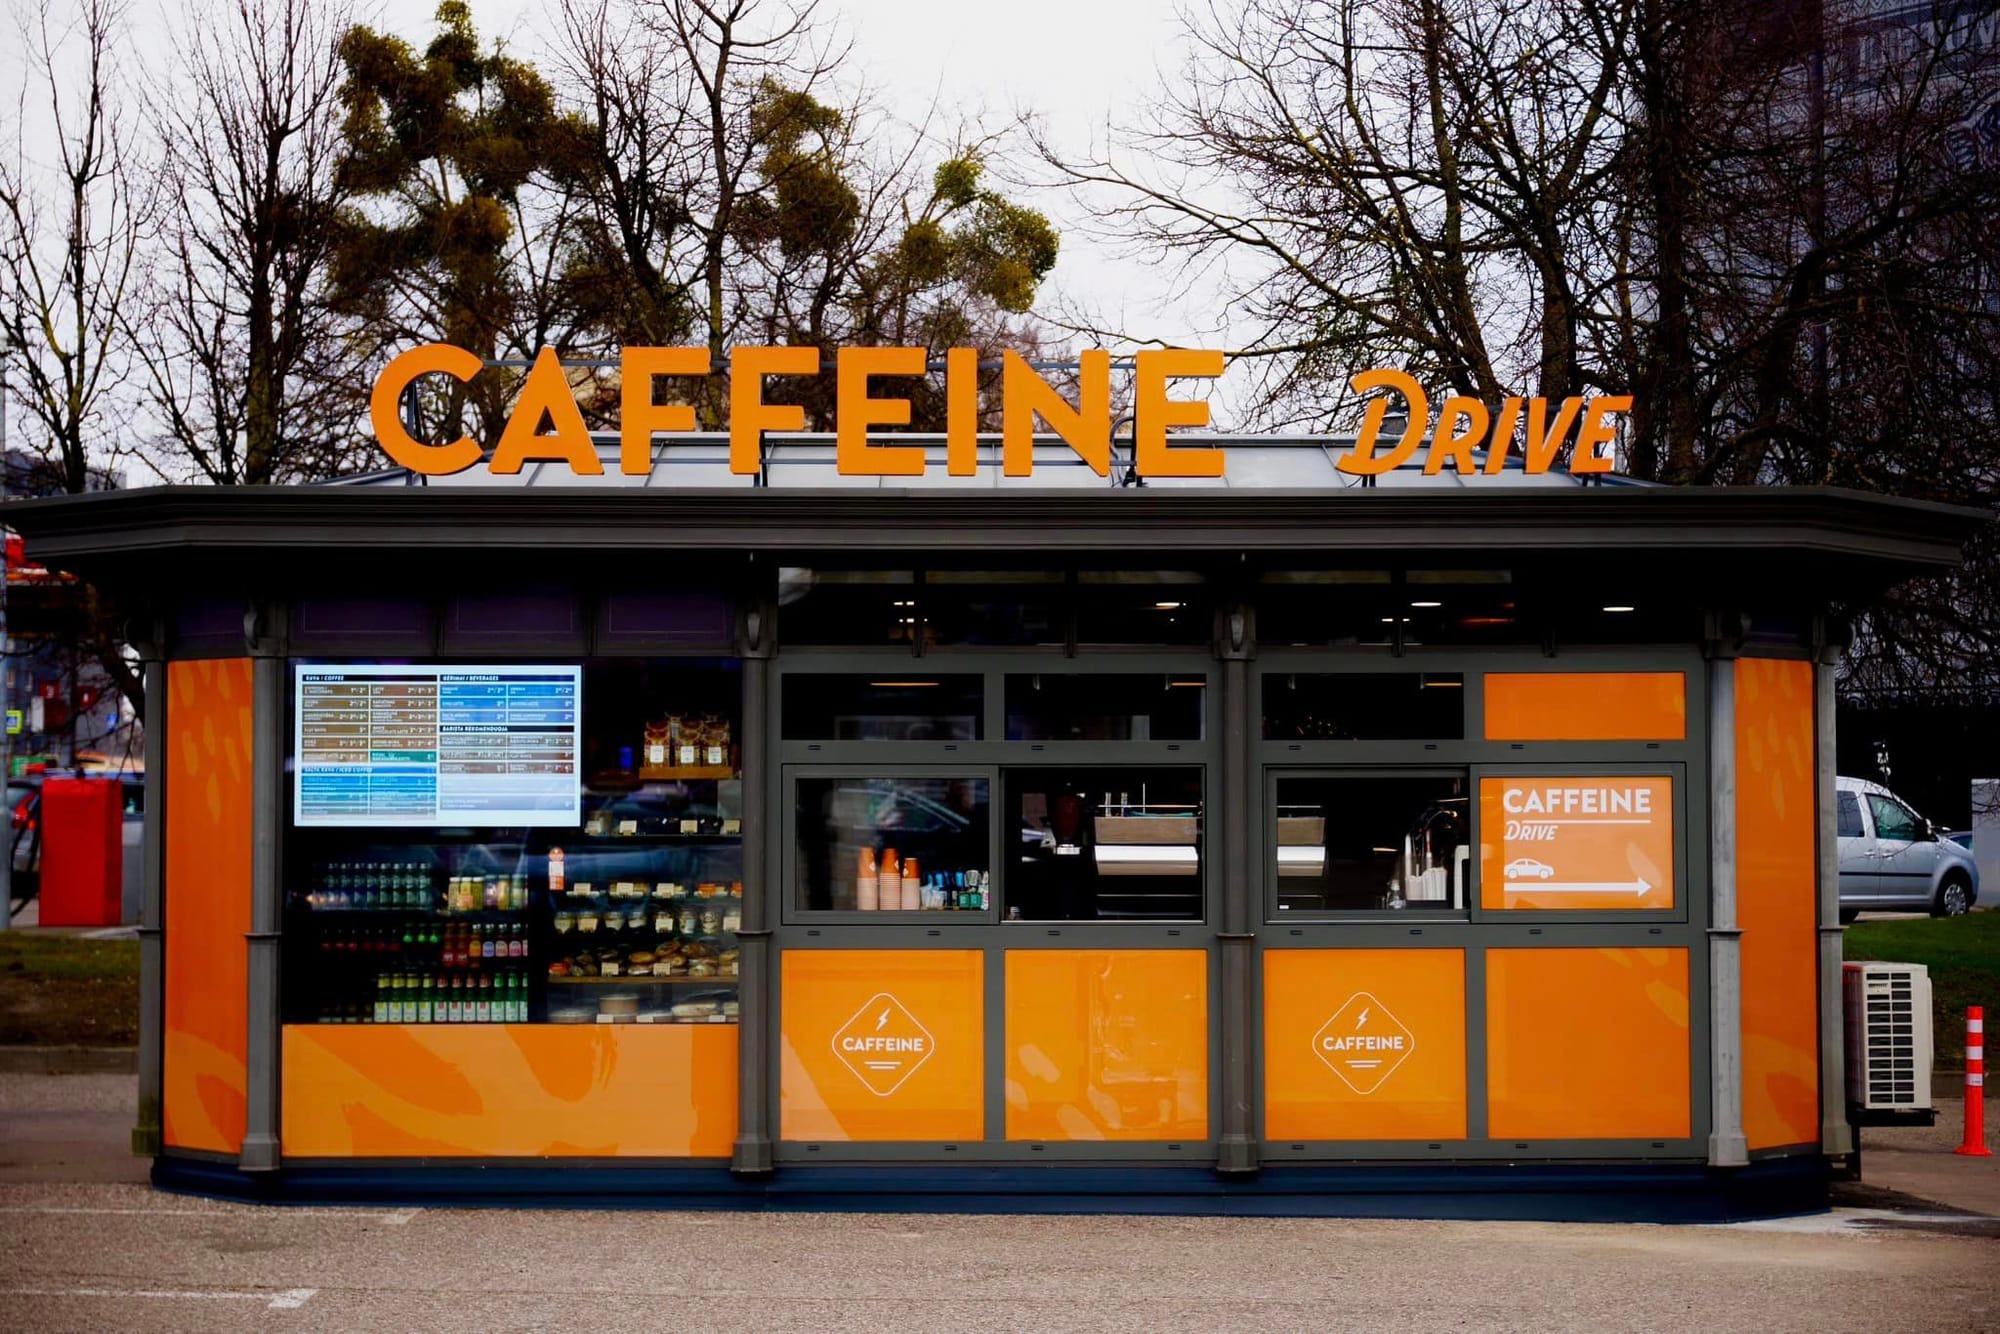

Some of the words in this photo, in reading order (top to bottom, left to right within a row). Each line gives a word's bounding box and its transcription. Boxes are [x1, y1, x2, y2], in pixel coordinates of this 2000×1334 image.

[369, 344, 1225, 477] CAFFEINE
[1335, 368, 1634, 476] DRIVE
[1503, 788, 1652, 814] CAFFEINE
[1503, 820, 1559, 841] DRIVE
[842, 1036, 924, 1052] CAFFEINE
[1322, 1036, 1404, 1051] CAFFEINE
